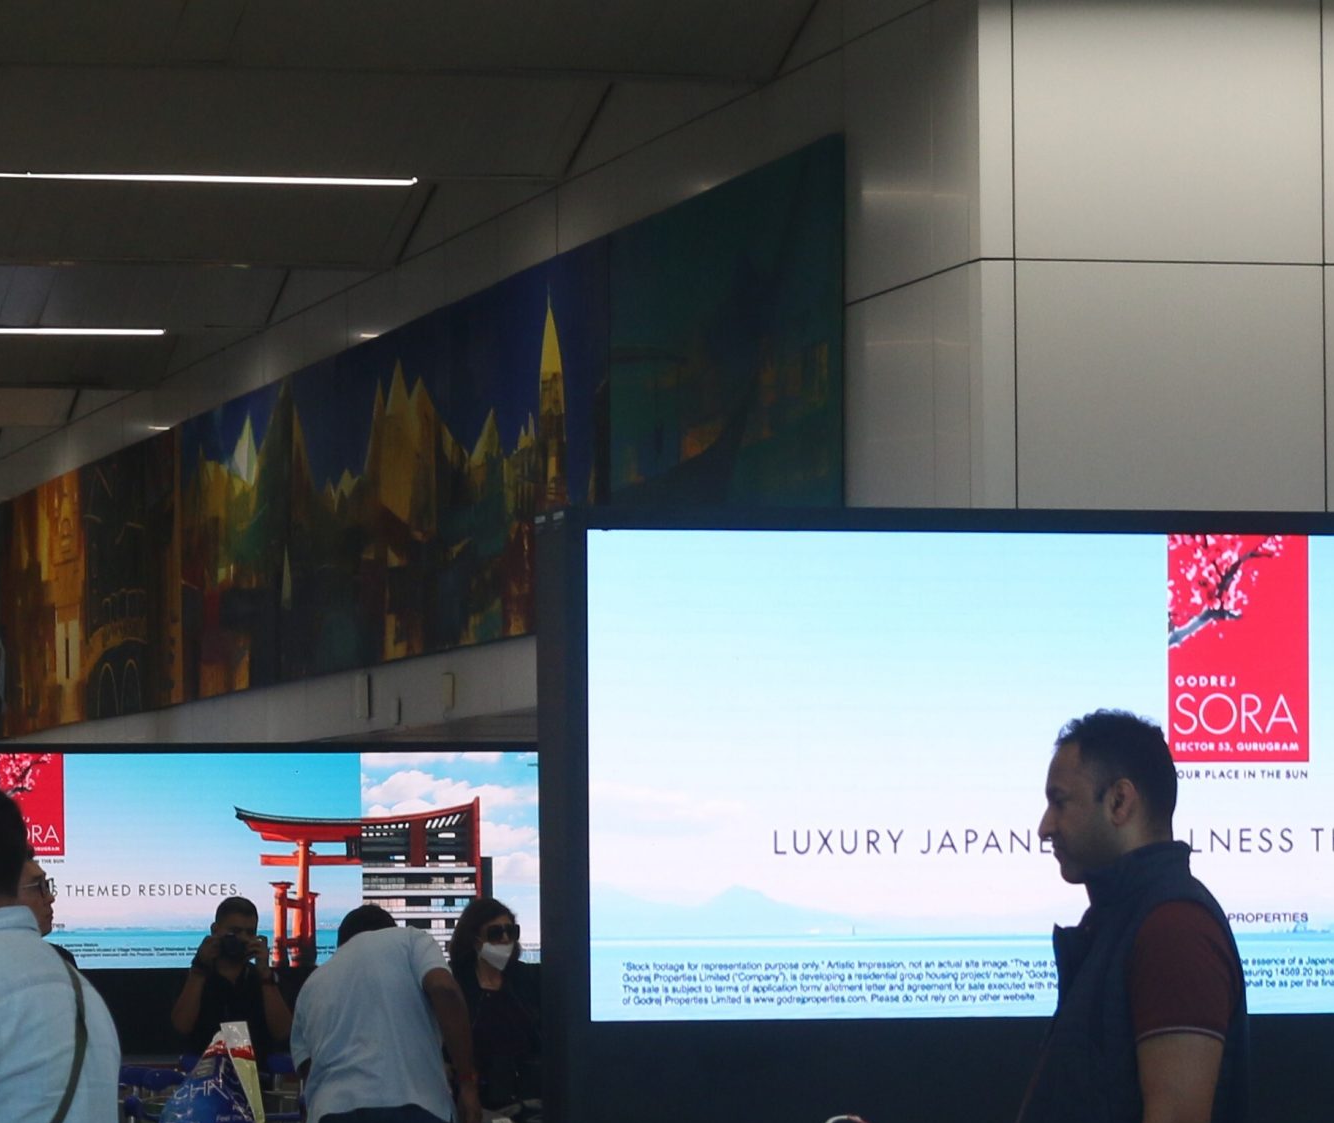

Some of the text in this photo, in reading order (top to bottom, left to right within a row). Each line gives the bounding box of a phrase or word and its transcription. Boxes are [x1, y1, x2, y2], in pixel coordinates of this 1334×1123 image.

[1174, 675, 1236, 688] GODREJ
[1173, 692, 1298, 735] SORA
[1175, 742, 1215, 752] SECTOR
[1236, 742, 1299, 752] GURUGRAM
[1175, 770, 1308, 780] OUR PLACE IN THE SUN
[774, 829, 904, 856] LUXURY
[920, 828, 1053, 855] JAPANE
[1188, 827, 1294, 854] LNESS
[66, 884, 132, 898] THEMED
[138, 883, 243, 897] RESIDENCES.
[1227, 911, 1309, 922] PROPERTIES
[653, 962, 685, 973] footage
[701, 962, 762, 973] representation
[765, 961, 799, 972] purpose
[938, 959, 963, 968] actual
[623, 970, 1024, 984] Godrej Properties Limited developing residential group housing namely
[623, 984, 639, 993] The
[672, 984, 702, 995] subject
[753, 983, 798, 994] application
[824, 982, 863, 992] allotment
[908, 982, 952, 993] agreement
[988, 980, 1025, 989] executed
[634, 995, 663, 1007] Godrej
[665, 995, 709, 1006] Properties
[711, 994, 742, 1004] Limited
[871, 993, 900, 1003] Please
